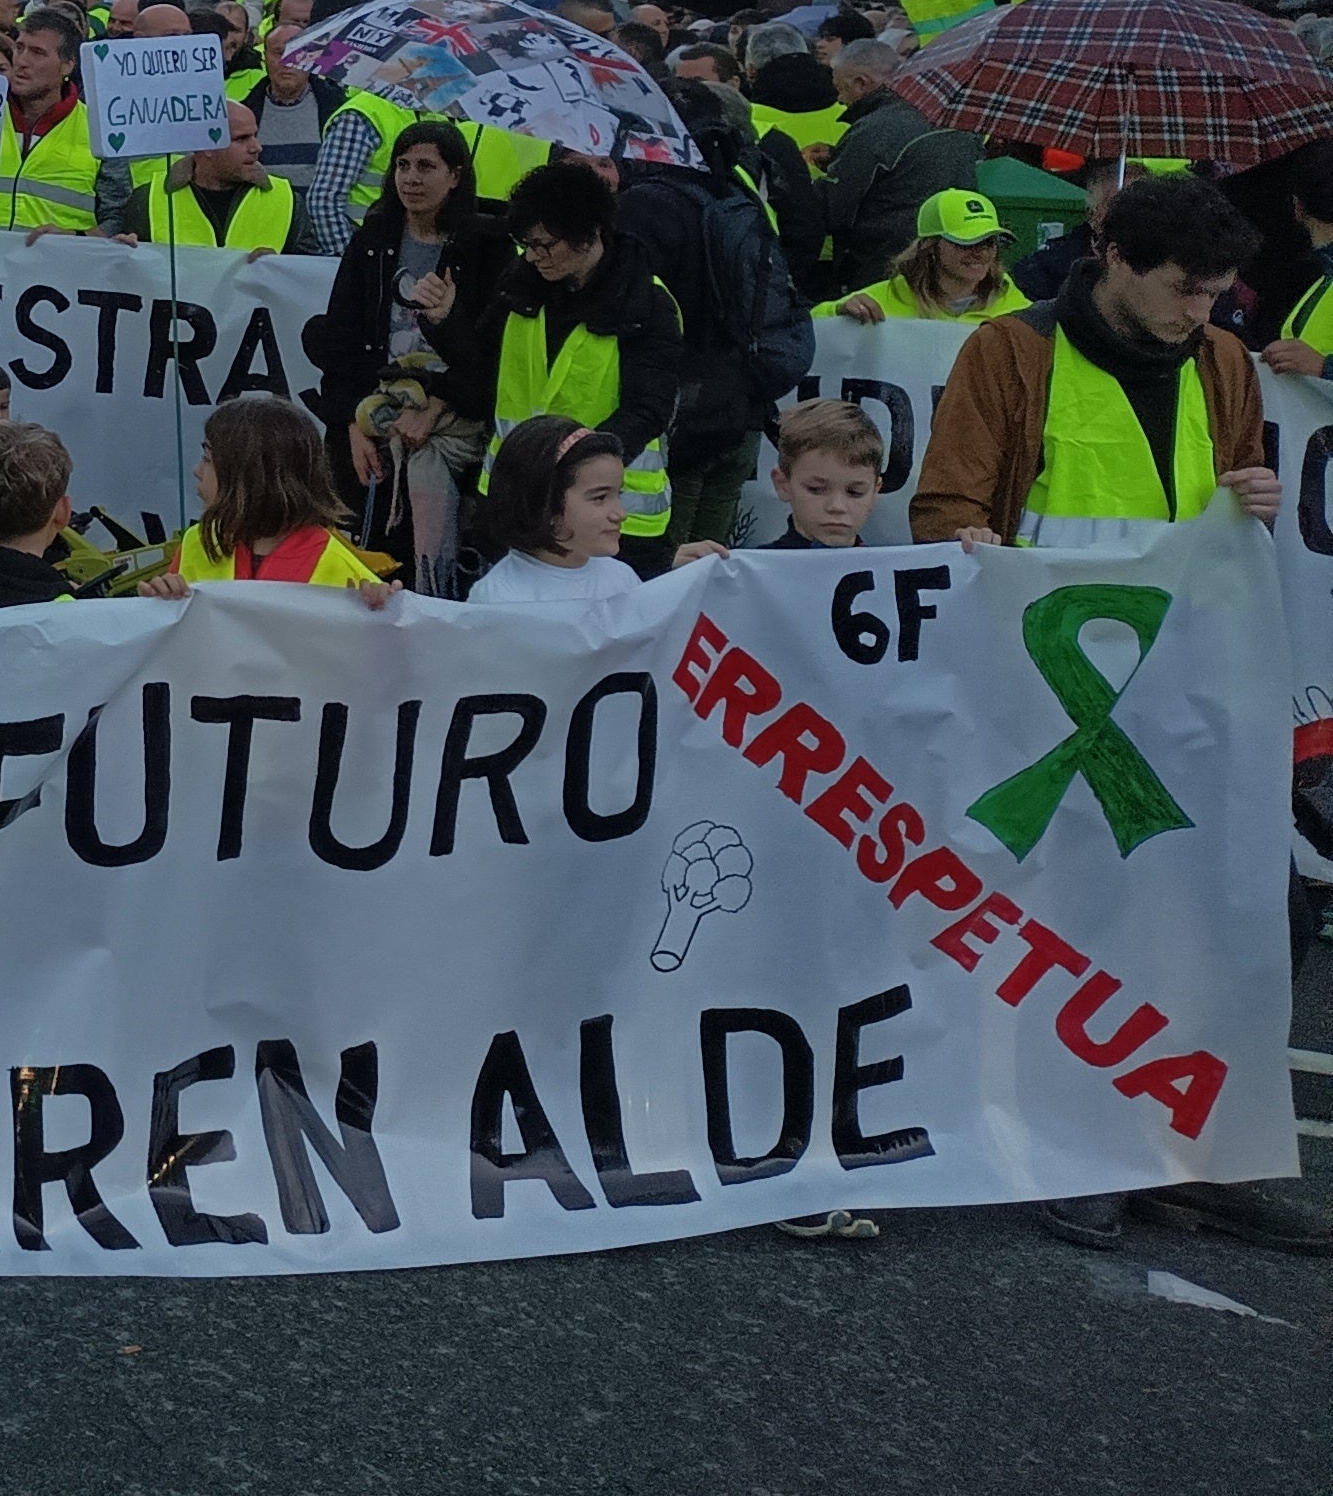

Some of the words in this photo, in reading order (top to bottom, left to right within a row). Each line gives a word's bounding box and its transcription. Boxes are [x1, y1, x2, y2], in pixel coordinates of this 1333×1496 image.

[114, 51, 136, 71] YO
[142, 49, 187, 70] QUIERO
[193, 47, 217, 67] SER
[108, 94, 227, 126] GANADERA
[832, 565, 951, 665] 6F
[672, 613, 1228, 1140] ERRESPETUA
[469, 984, 936, 1220] ALDE
